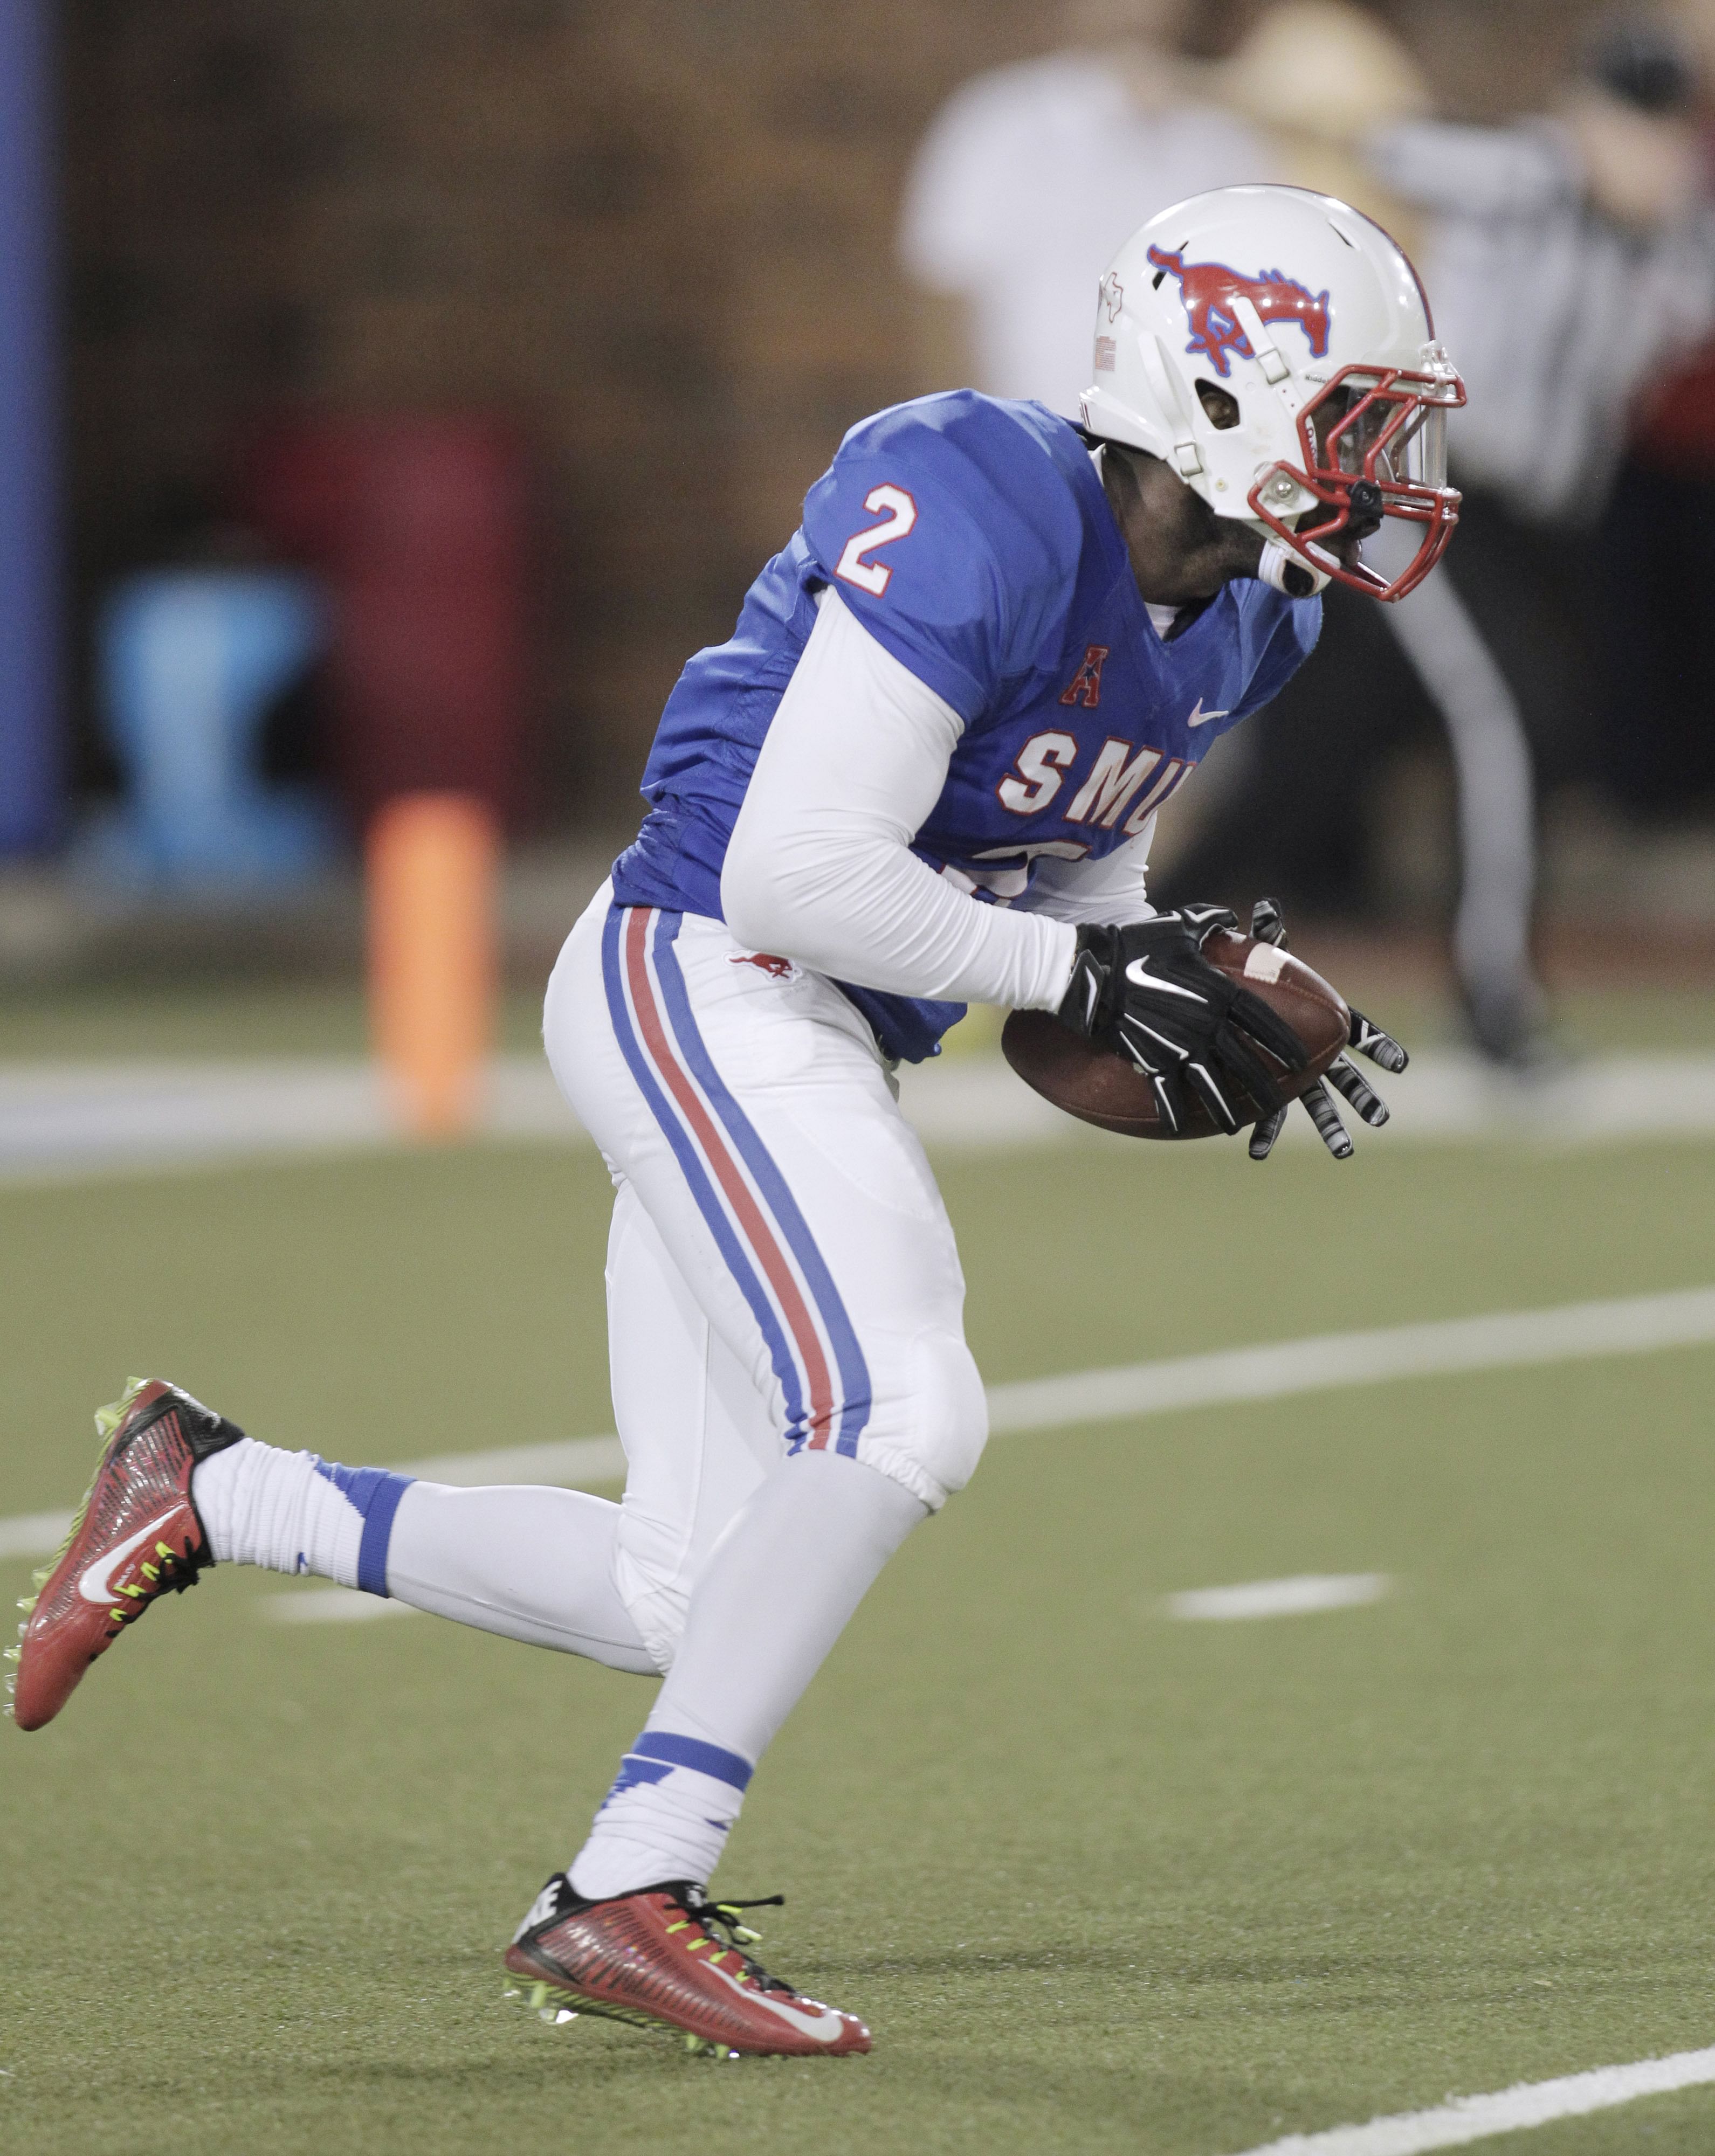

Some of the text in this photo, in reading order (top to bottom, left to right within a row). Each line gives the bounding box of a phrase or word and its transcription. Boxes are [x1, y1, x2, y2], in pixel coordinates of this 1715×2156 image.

[834, 482, 918, 598] 2
[1059, 644, 1110, 709] A
[995, 728, 1197, 838] SMU
